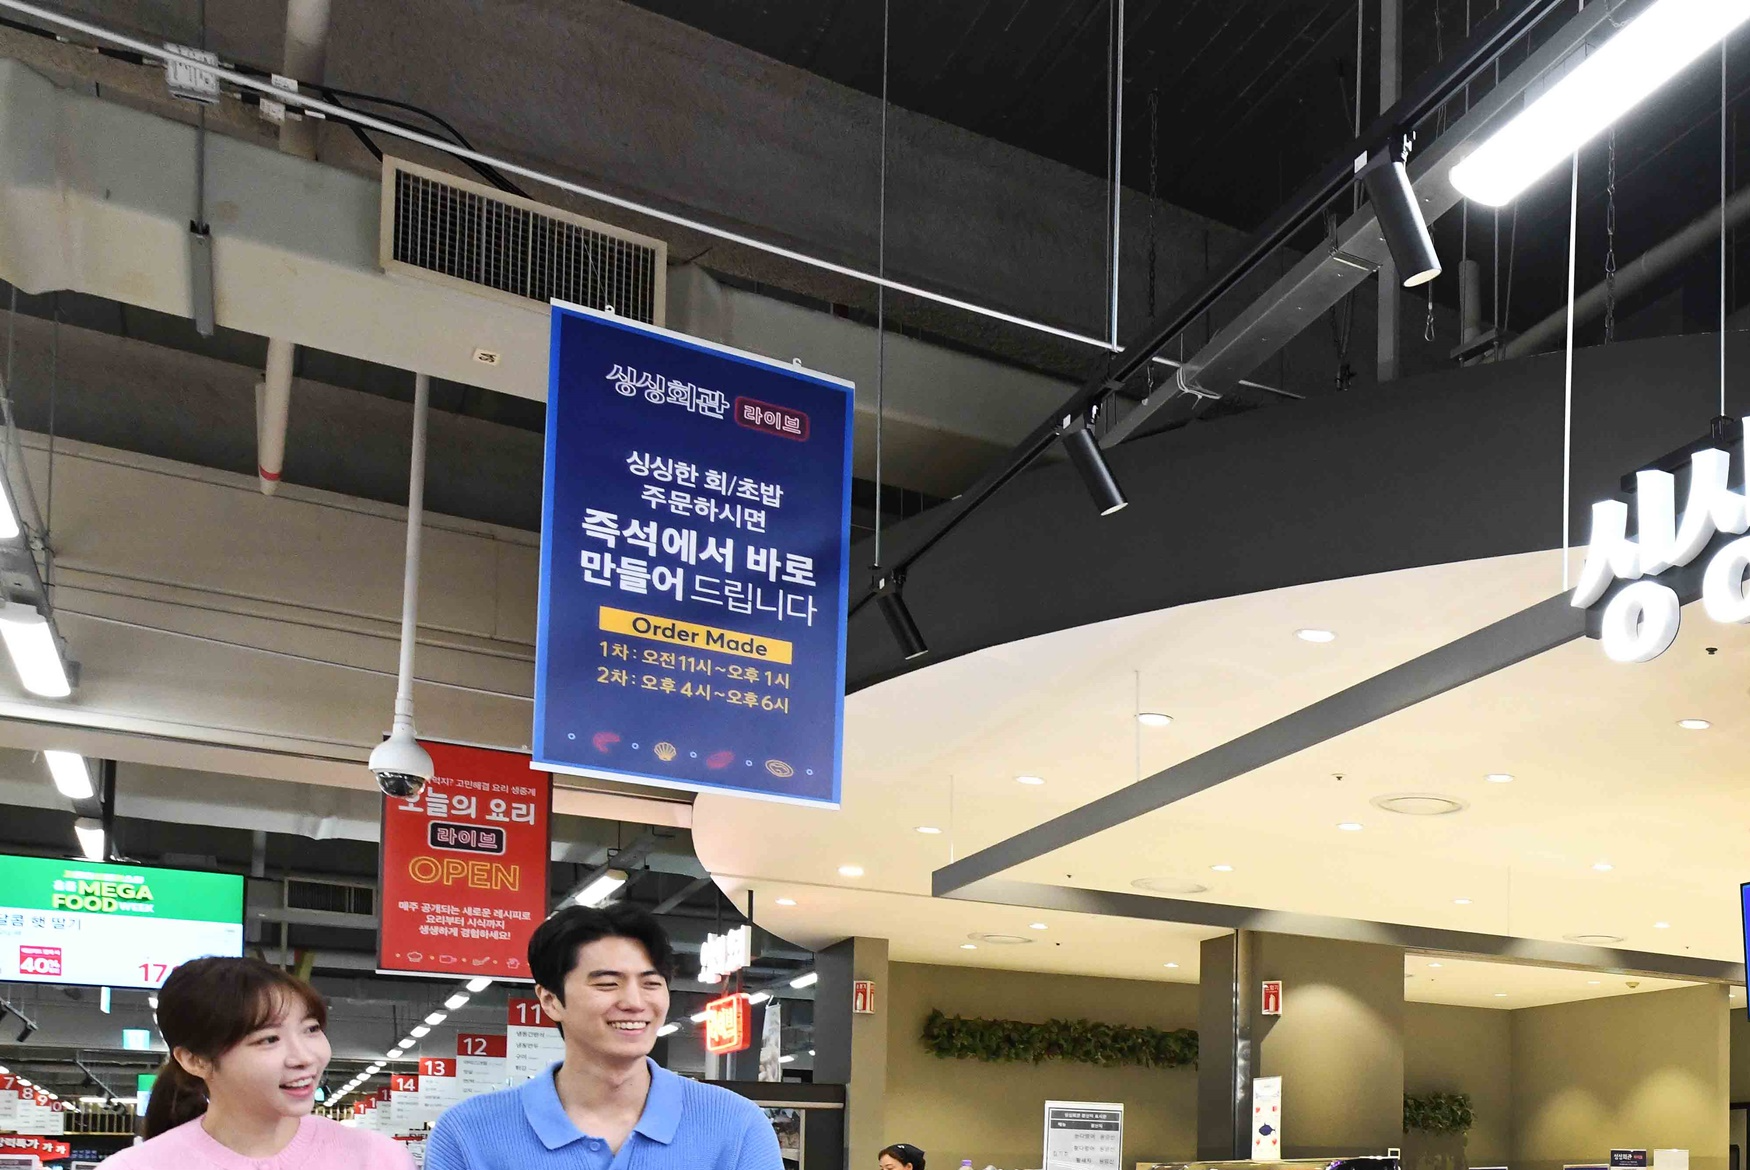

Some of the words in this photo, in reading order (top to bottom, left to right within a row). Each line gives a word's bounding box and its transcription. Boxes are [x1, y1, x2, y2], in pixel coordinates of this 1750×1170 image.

[606, 363, 730, 420] 싱싱회관
[742, 402, 803, 436] 라이브
[626, 450, 698, 488] 싱싱한
[704, 467, 784, 508] 회/초밥
[641, 484, 766, 533] 주문하시면
[581, 508, 733, 567] 즉석에서
[747, 546, 817, 588] 바로
[580, 549, 684, 601] 만들어
[690, 571, 817, 627] 드립니다
[631, 616, 700, 644] Order
[704, 628, 768, 658] Made
[492, 783, 509, 794] 요리
[485, 798, 536, 826] 요리
[437, 827, 498, 850] 라이브
[408, 855, 520, 892] OPEN
[77, 879, 154, 900] MEGA
[52, 892, 119, 913] FOOD
[398, 901, 419, 912] 매주
[421, 902, 461, 916] 공개되는
[462, 906, 492, 918] 새로운
[493, 909, 532, 921] 레시피로
[419, 924, 458, 937] 생생하게
[460, 927, 511, 940] 경험하세요!
[426, 914, 465, 926] 요리부터
[467, 917, 505, 930] 시식까지
[516, 1002, 541, 1025] 11
[463, 1037, 488, 1056] 12
[424, 1060, 446, 1077] 13
[4, 1076, 14, 1090] 7
[22, 1087, 34, 1100] 8
[396, 1078, 416, 1092] 14
[37, 1095, 48, 1106] 9
